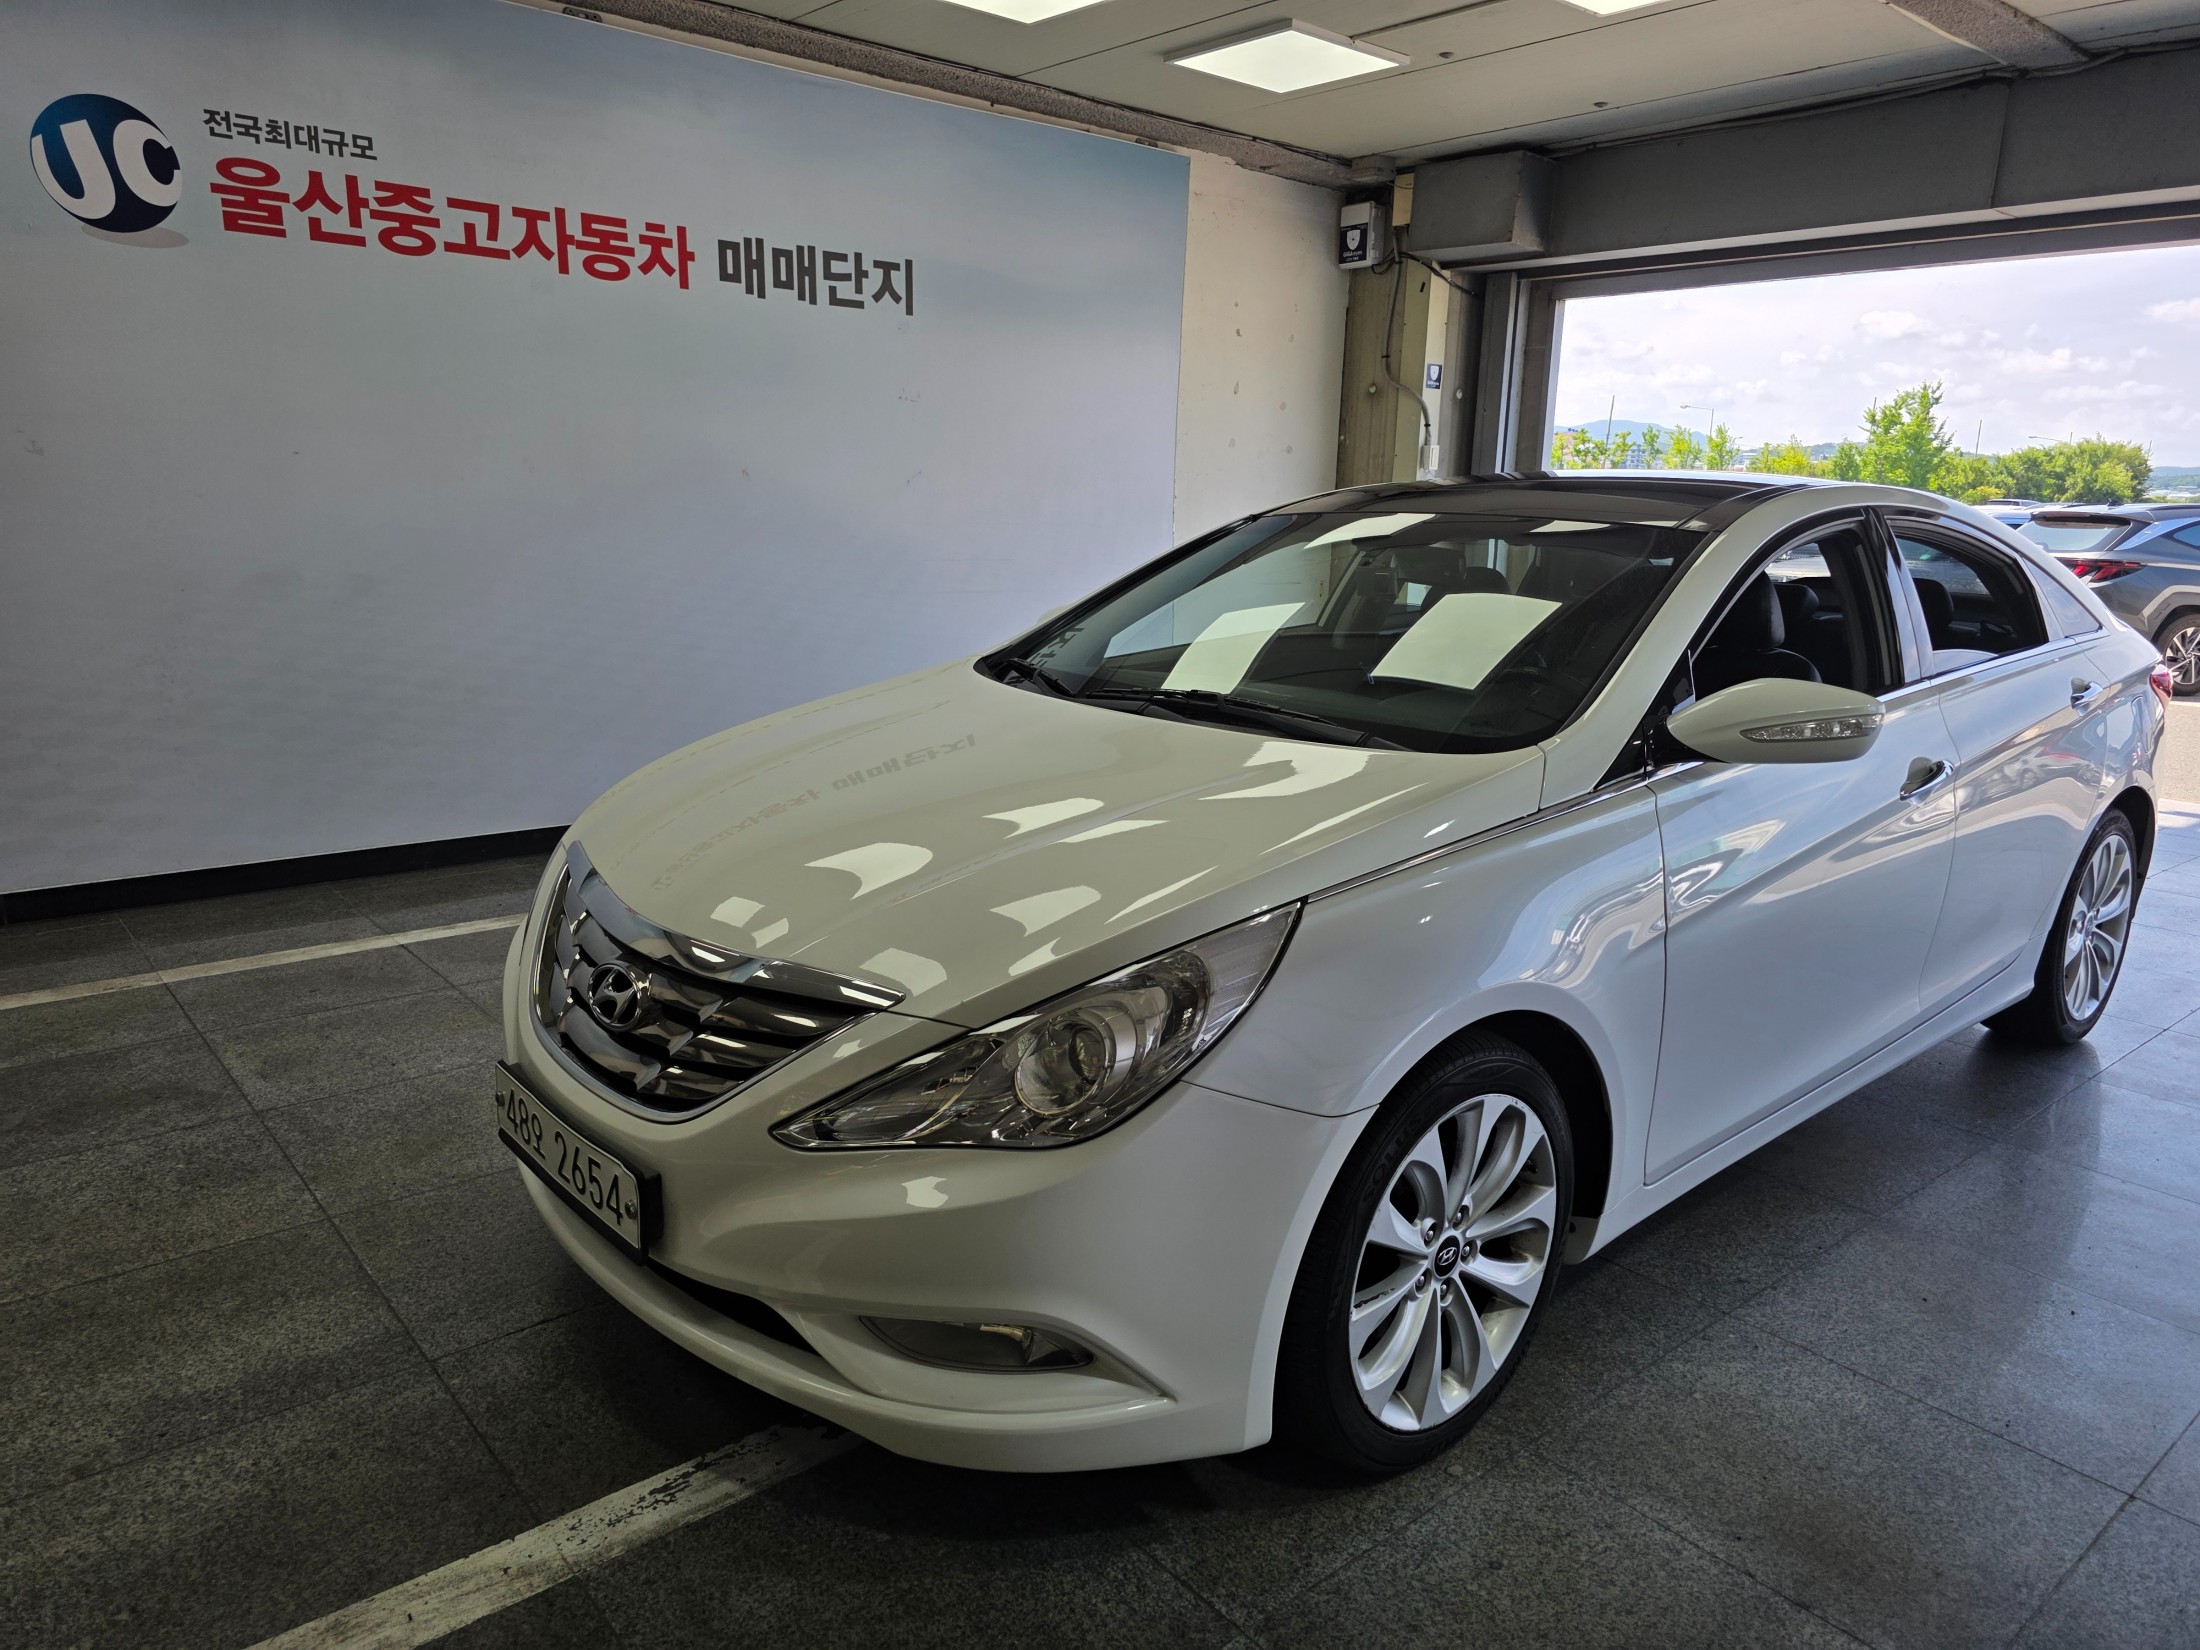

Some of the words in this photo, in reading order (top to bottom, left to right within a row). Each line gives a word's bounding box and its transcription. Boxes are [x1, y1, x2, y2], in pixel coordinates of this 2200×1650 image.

[203, 109, 378, 161] 전국최대규모
[208, 156, 696, 289] 울산중고자동차
[717, 236, 915, 316] 매매단지
[507, 1089, 546, 1160] 48오
[555, 1130, 624, 1226] 2654
